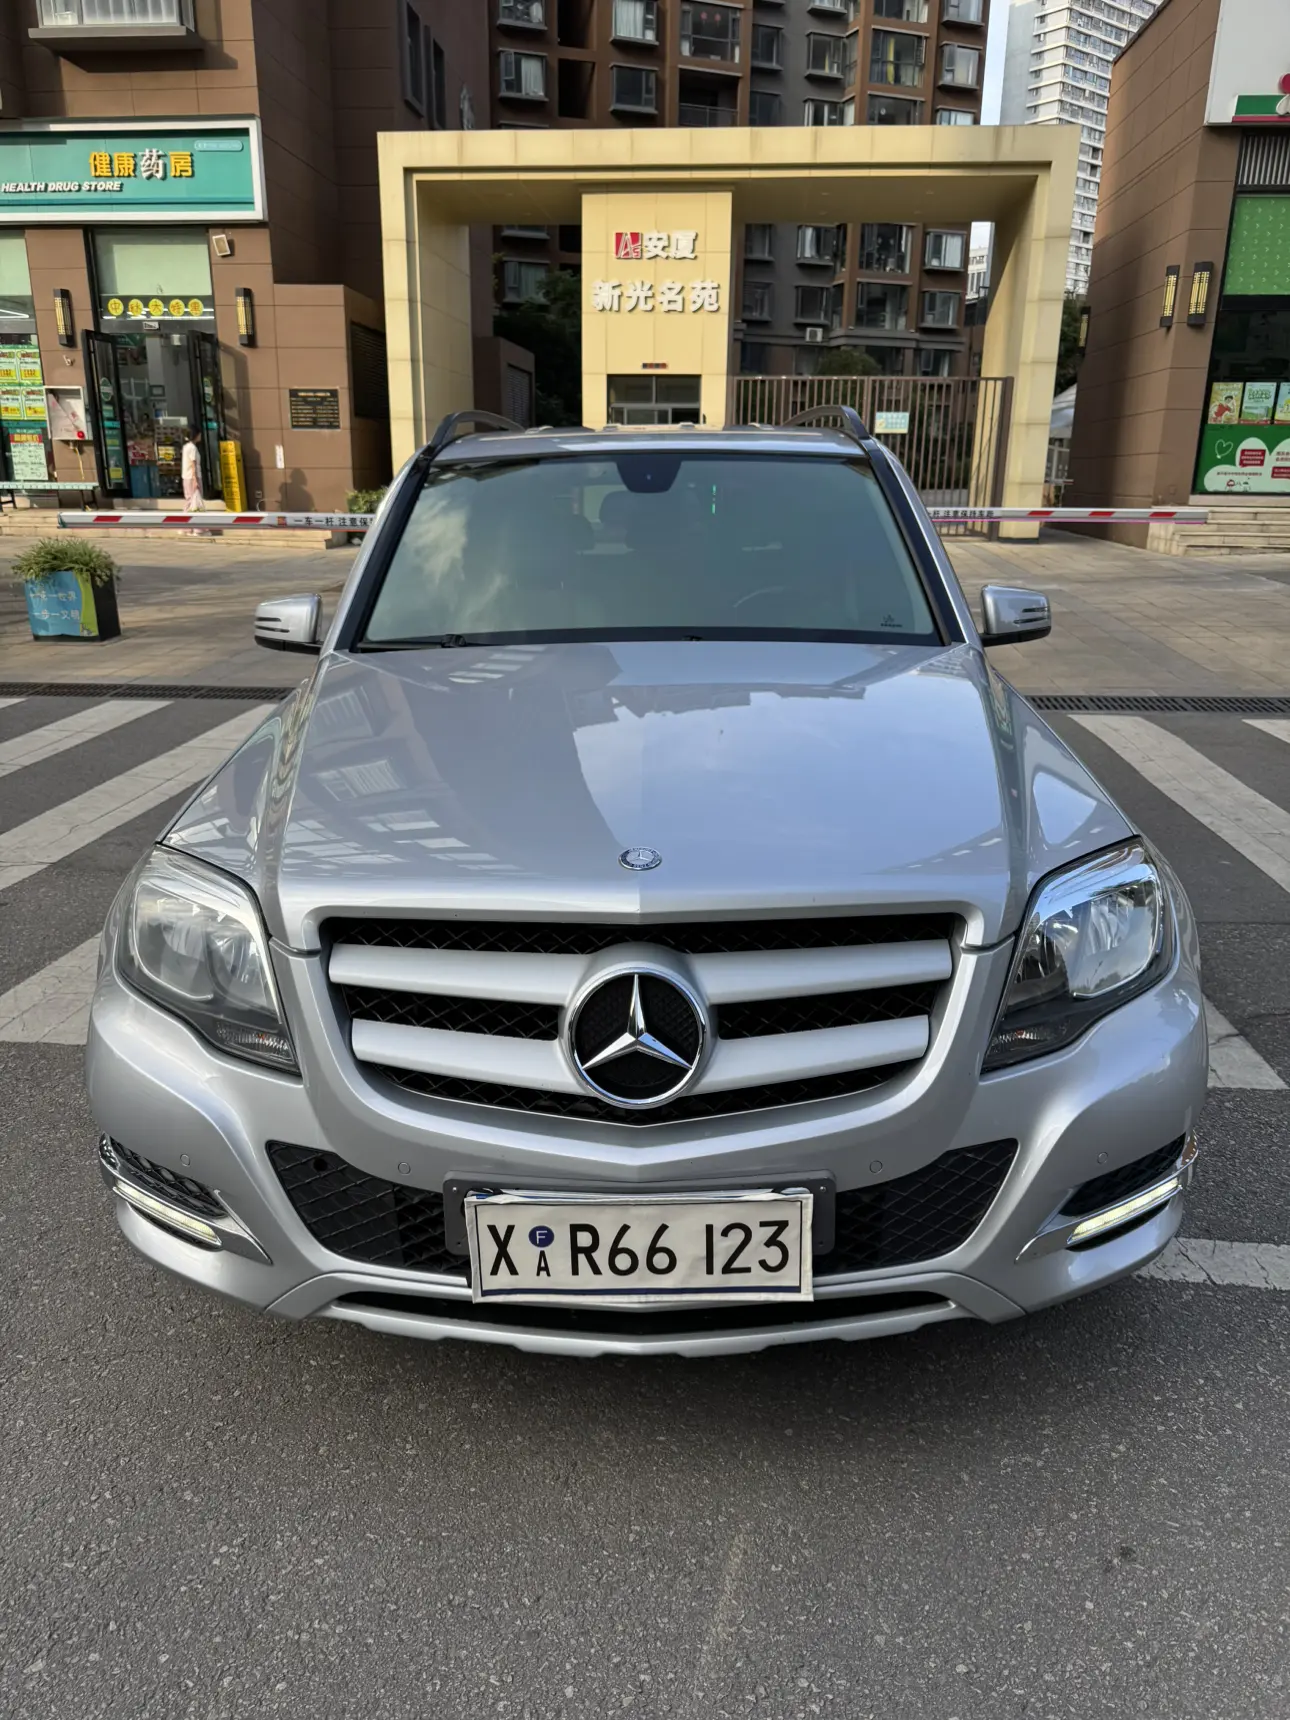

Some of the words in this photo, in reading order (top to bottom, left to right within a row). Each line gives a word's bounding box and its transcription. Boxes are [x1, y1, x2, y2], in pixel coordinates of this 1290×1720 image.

[89, 148, 193, 179] 健康药房
[1, 182, 45, 192] HEALTH
[48, 182, 79, 192] DRUG
[82, 181, 122, 191] STORE
[644, 231, 698, 259] 安厦
[592, 280, 720, 312] 新光名苑
[486, 1224, 519, 1277] X
[536, 1250, 551, 1277] A
[569, 1223, 677, 1277] R66
[705, 1220, 790, 1275] 123
